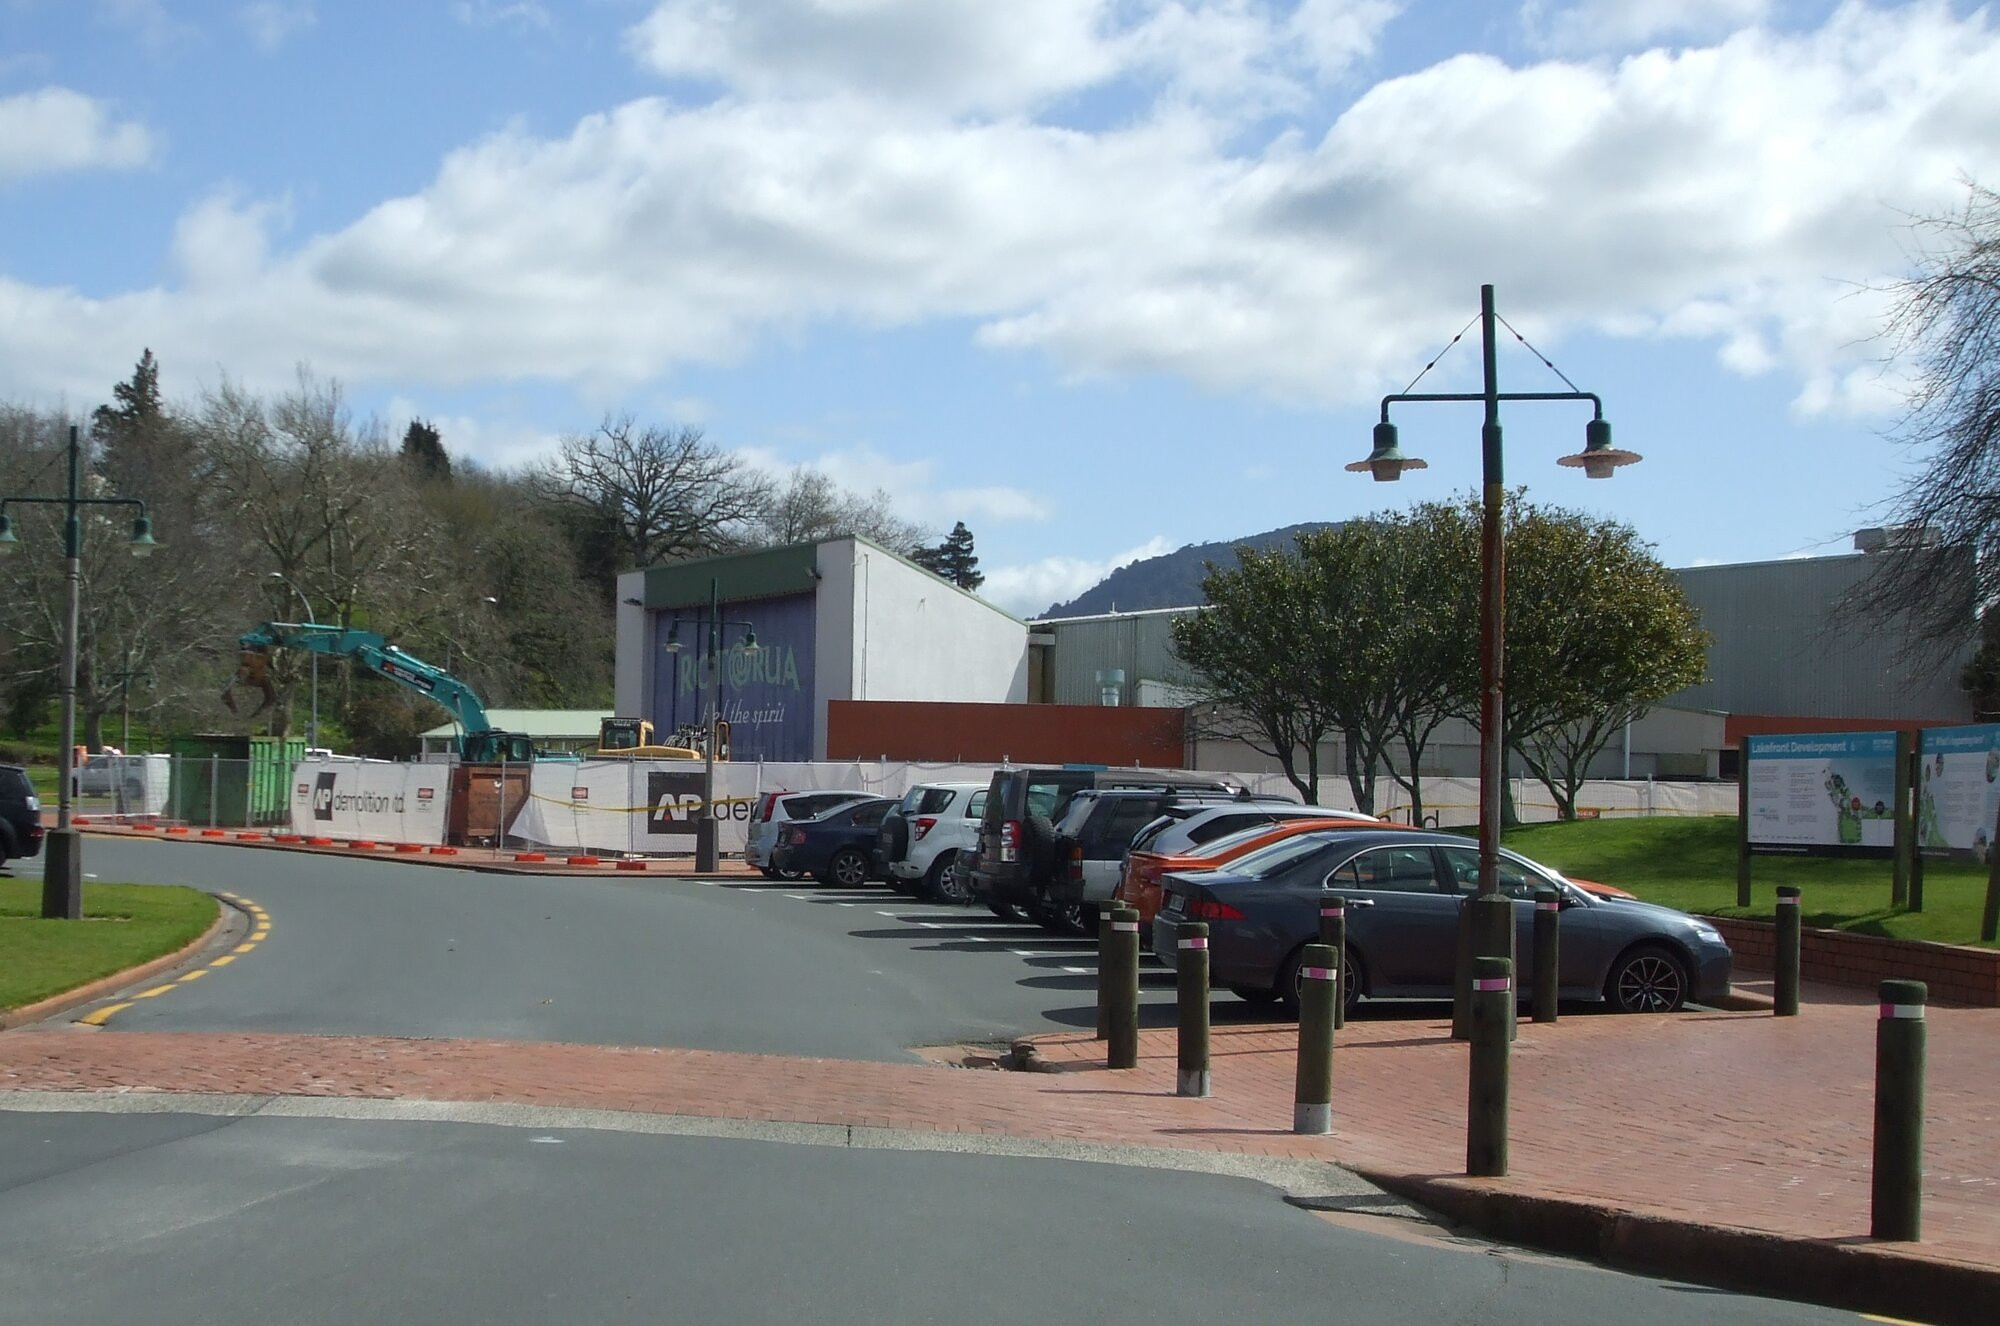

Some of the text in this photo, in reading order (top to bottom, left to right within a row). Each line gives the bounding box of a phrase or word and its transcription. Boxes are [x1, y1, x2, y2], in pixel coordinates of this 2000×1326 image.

[729, 698, 749, 724] the
[752, 703, 785, 731] spirit
[1752, 740, 1847, 755] Lakefront Development
[313, 788, 331, 810] AP
[334, 790, 390, 813] demolition
[653, 793, 702, 821] AP
